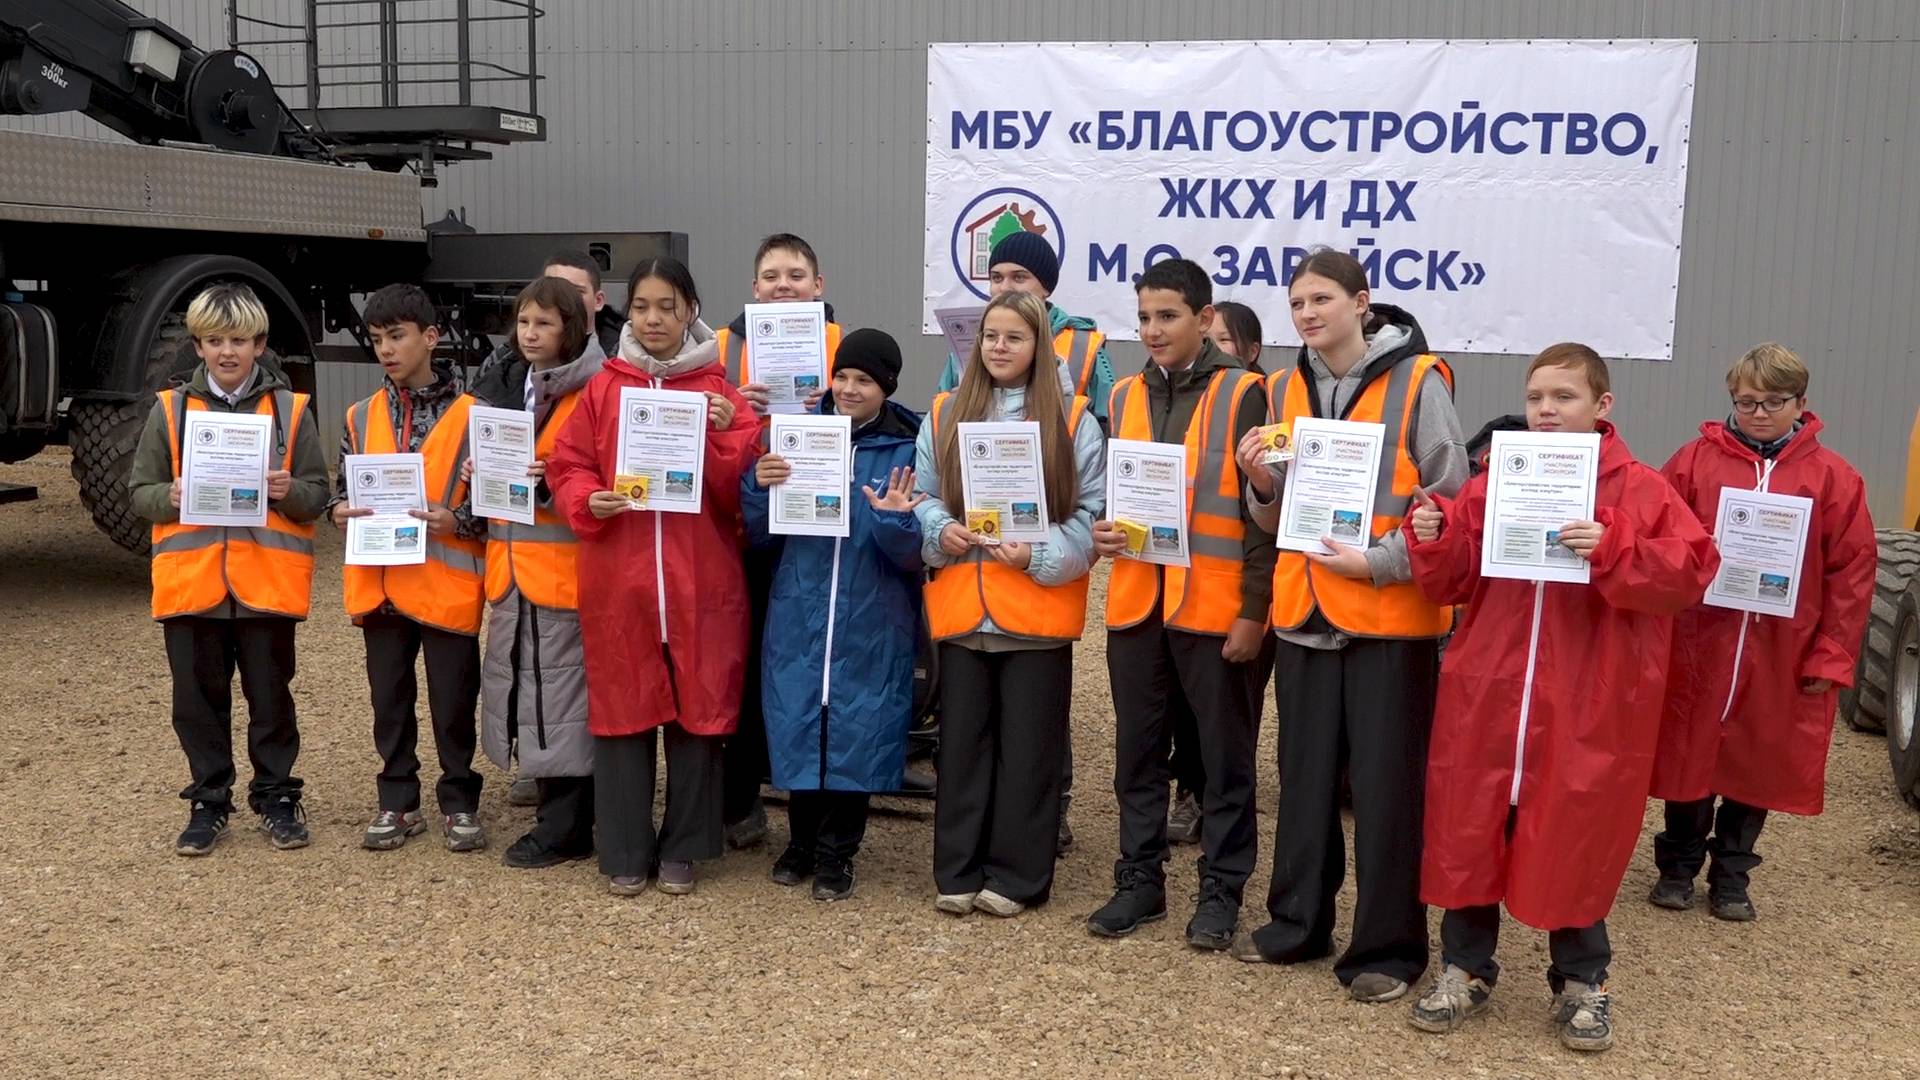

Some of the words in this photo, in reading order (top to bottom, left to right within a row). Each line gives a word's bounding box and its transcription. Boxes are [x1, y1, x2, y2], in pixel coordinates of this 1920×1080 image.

[951, 110, 1052, 150] МБУ
[1068, 101, 1659, 164] «БЛАГОУСТРОЙСТВО,
[1158, 178, 1277, 220] ЖКХ
[1293, 179, 1327, 221] И
[1341, 180, 1419, 228] ДХ
[1212, 237, 1486, 292] ЗАРЙСК»
